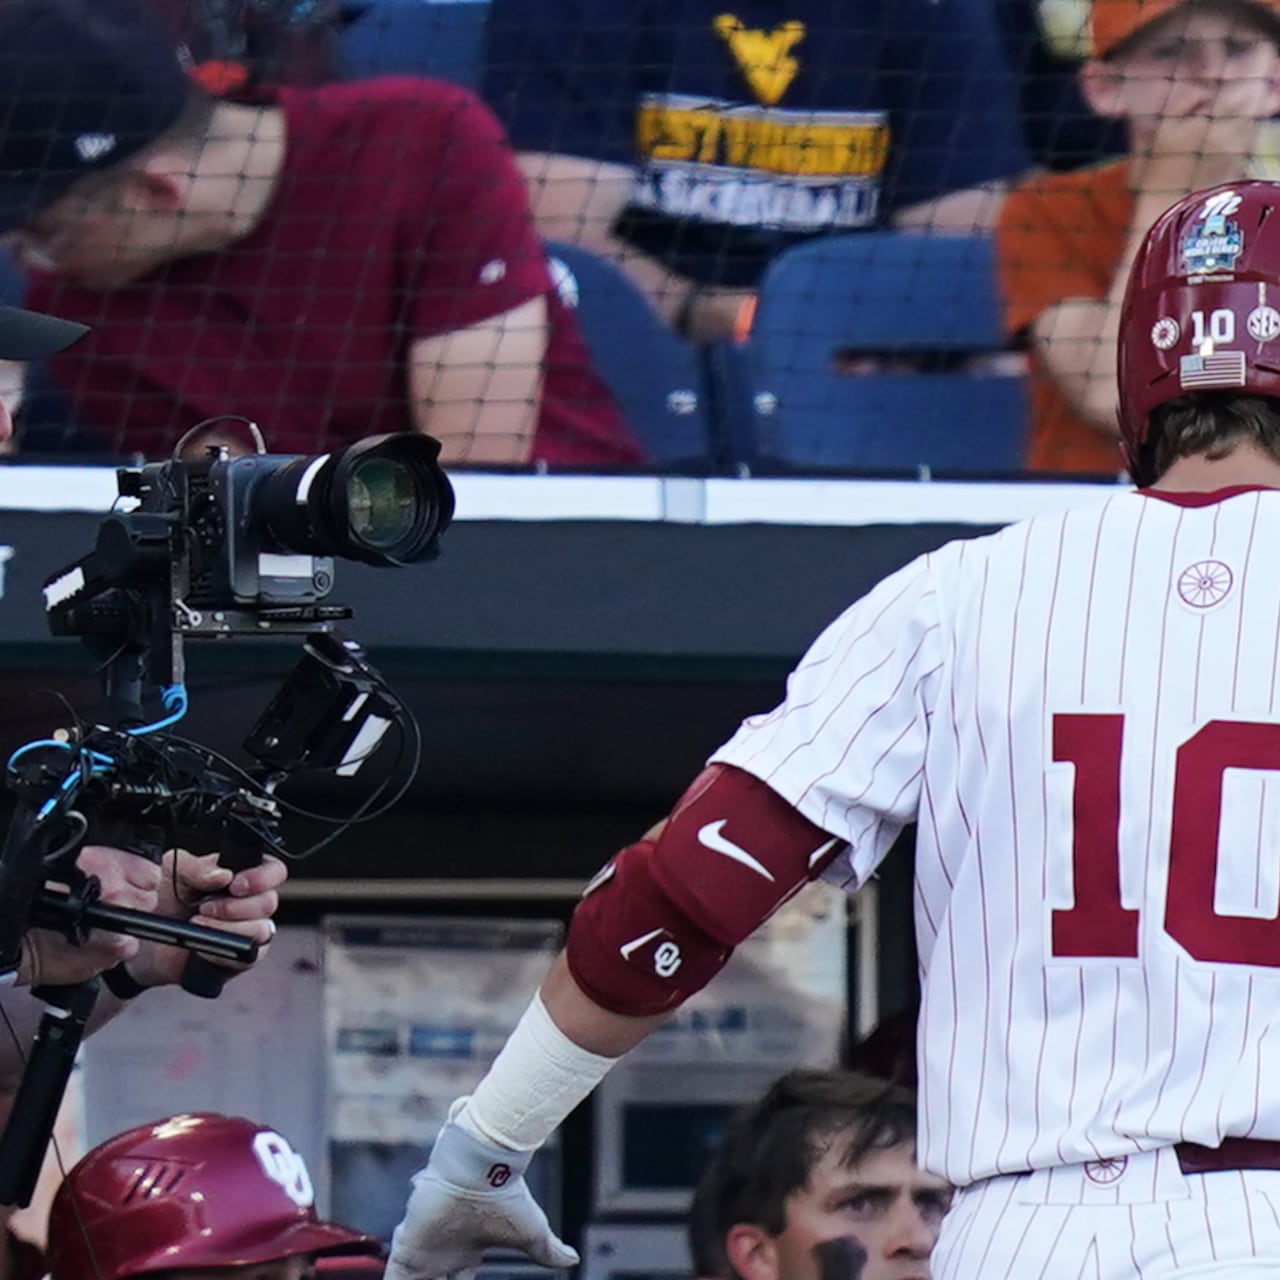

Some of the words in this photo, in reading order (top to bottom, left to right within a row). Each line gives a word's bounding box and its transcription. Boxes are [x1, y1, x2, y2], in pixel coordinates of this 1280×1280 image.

[1192, 309, 1235, 346] 10
[1250, 314, 1280, 337] SEC
[253, 1131, 314, 1207] OU
